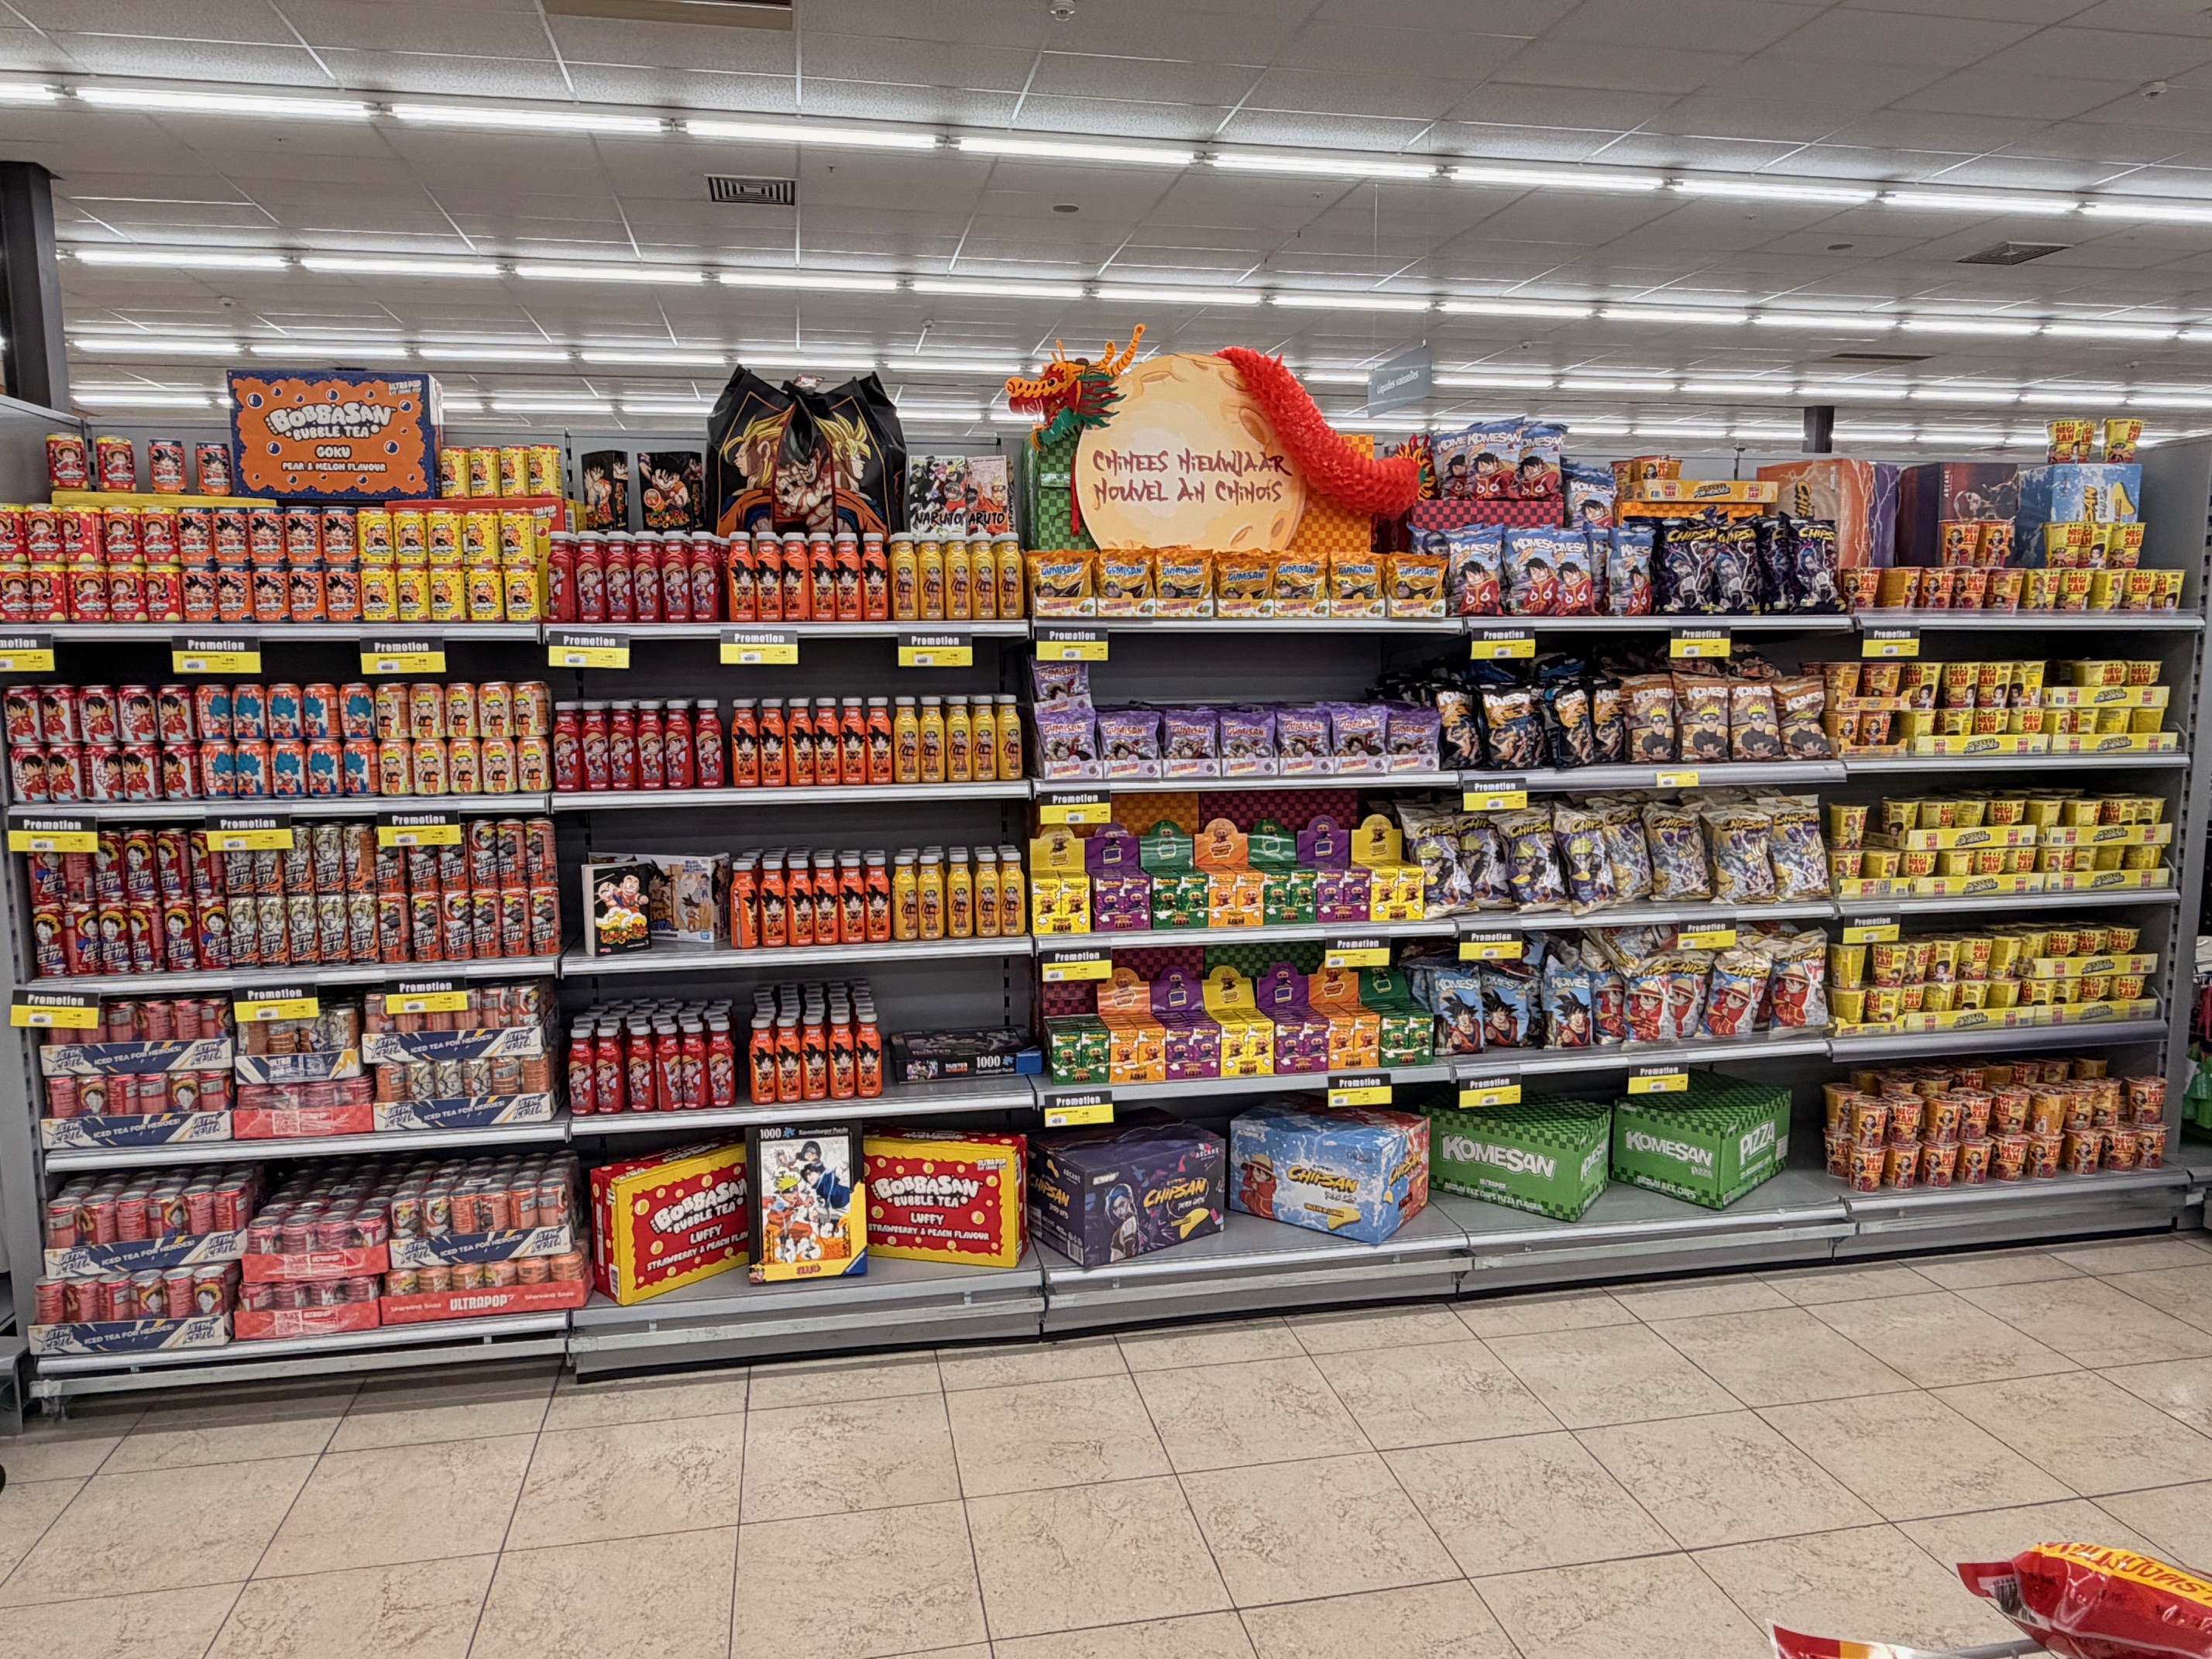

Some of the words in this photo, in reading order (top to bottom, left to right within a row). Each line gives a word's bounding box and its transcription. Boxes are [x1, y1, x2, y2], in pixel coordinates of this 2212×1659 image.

[268, 401, 393, 433] BOBBASAN
[293, 427, 341, 440] BUBBLE
[346, 426, 370, 438] TEA
[1467, 432, 1521, 445] KOMESAN
[316, 446, 351, 459] GOKU
[282, 462, 304, 471] PEAR
[315, 463, 345, 472] MELON
[349, 463, 386, 472] FLAVOUR
[1093, 477, 1169, 504] NOUVEL
[1177, 477, 1205, 503] AN
[912, 511, 963, 529] NARUTO
[563, 635, 616, 647] Promotion
[734, 634, 785, 644] Promotion
[911, 635, 960, 646] Promotion
[1049, 630, 1096, 641] Promotion
[188, 640, 245, 651] Promotion
[375, 642, 429, 653] Promotion
[1475, 781, 1516, 791] Promotion
[1052, 794, 1098, 804] Promotion
[24, 819, 81, 830] Promotion
[221, 818, 276, 829] Promotion
[392, 814, 446, 825] Promotion
[1982, 855, 2000, 864] NEGI
[1908, 864, 1926, 873] SAN
[1981, 863, 1999, 871] SAN
[1471, 933, 1512, 942] Promotion
[1337, 939, 1379, 949] Promotion
[1055, 951, 1101, 961] Promotion
[399, 981, 453, 992] Promotion
[248, 988, 303, 999] Promotion
[28, 994, 85, 1006] Promotion
[429, 1042, 445, 1051] TEA
[94, 1057, 112, 1066] ICED
[131, 1052, 147, 1060] FOR
[975, 1055, 1001, 1068] 1000
[1338, 1078, 1380, 1087] Promotion
[1056, 1096, 1101, 1106] Promotion
[760, 1128, 782, 1139] 1000
[1626, 1131, 1712, 1167] KOMESAN
[1740, 1120, 1776, 1167] PIZZA
[1442, 1135, 1555, 1179] KOMESAN
[1287, 1165, 1358, 1193] CHIPSAN
[875, 1175, 980, 1199] BOBBASAN
[1144, 1177, 1207, 1207] CHIPSAN
[894, 1196, 933, 1207] BUBBLE
[936, 1195, 960, 1207] TEA
[673, 1208, 713, 1234] BUBBLE
[716, 1201, 736, 1216] TEA
[910, 1212, 944, 1225] LUFFY
[689, 1224, 723, 1244] LUFFY
[868, 1224, 919, 1235] STRAWBERRY
[928, 1228, 952, 1238] PEACH
[954, 1230, 990, 1241] FLAVOUR
[440, 1249, 458, 1257] ICED
[476, 1242, 491, 1250] FOR
[647, 1248, 697, 1271] STRAWBERRY
[706, 1238, 730, 1251] PEACH
[450, 1294, 508, 1311] ULTRAPOP
